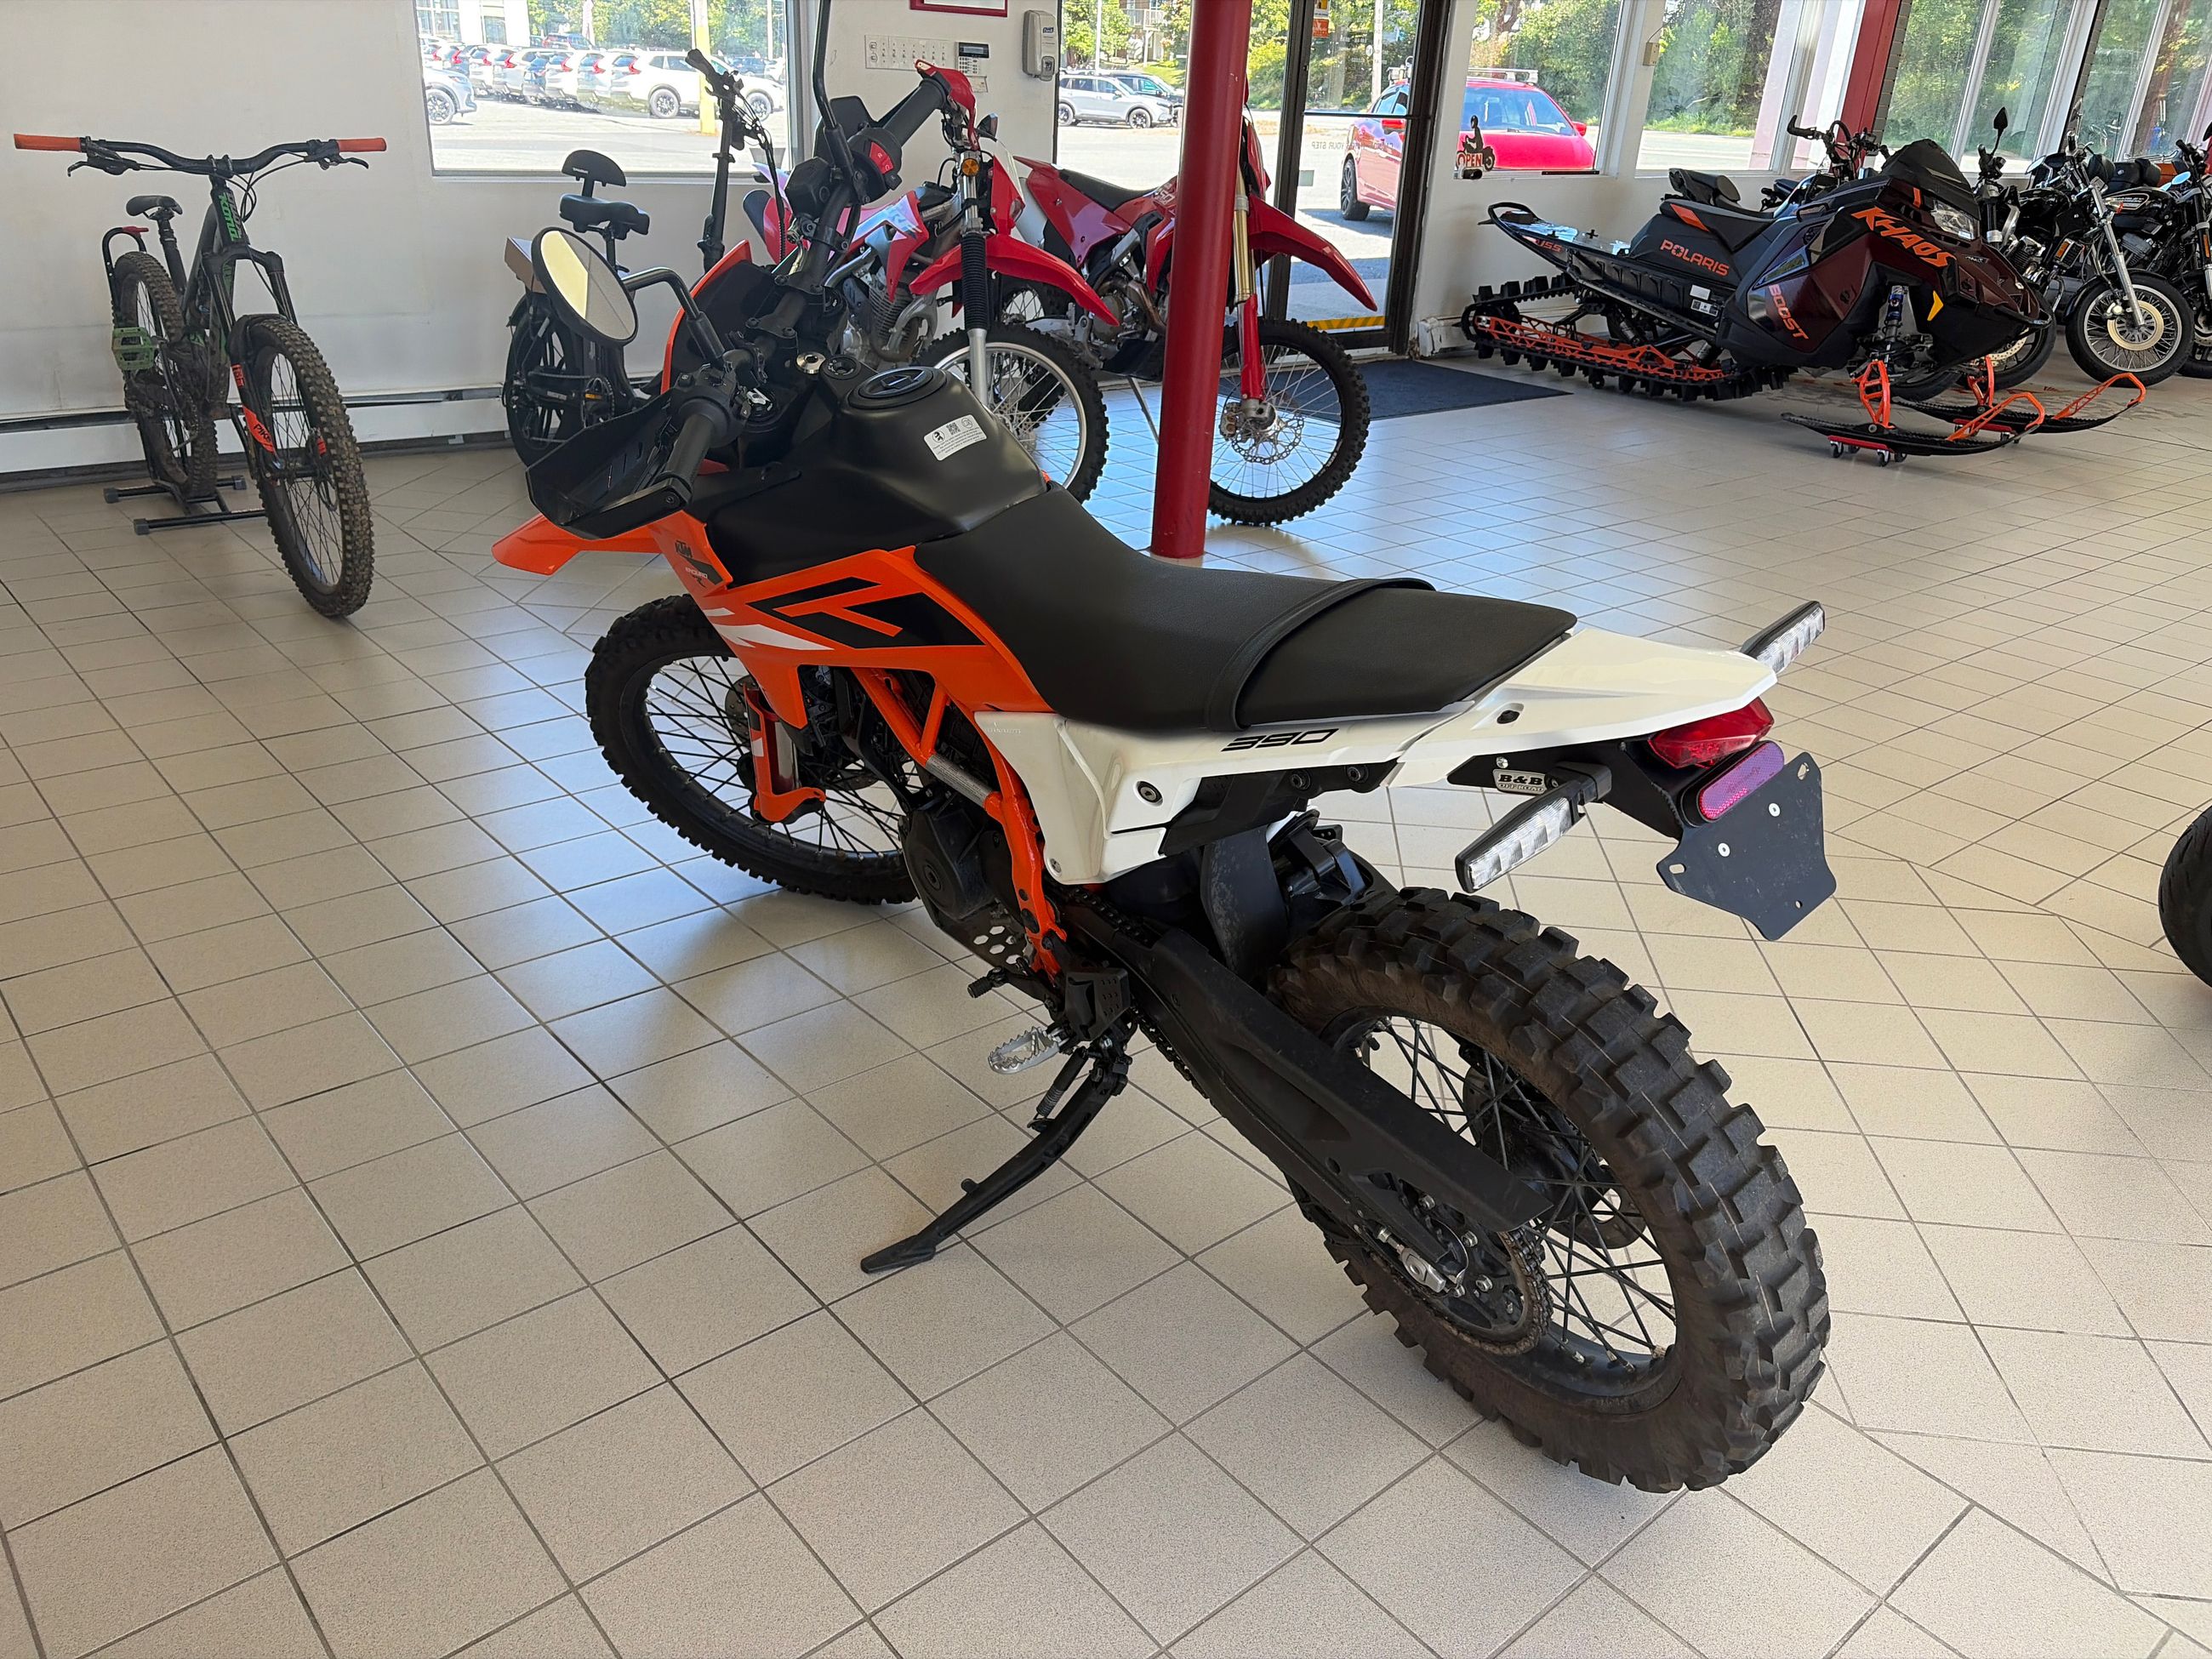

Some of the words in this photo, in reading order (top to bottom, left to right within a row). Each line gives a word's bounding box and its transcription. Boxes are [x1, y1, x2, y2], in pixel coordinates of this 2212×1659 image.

[1457, 153, 1482, 168] OPEN
[1851, 206, 1957, 267] KHAOS
[1660, 239, 1730, 277] POLARIS
[1769, 283, 1809, 339] BOOST
[675, 539, 693, 558] KTM
[1221, 728, 1339, 752] 390
[1498, 774, 1542, 785] B&B
